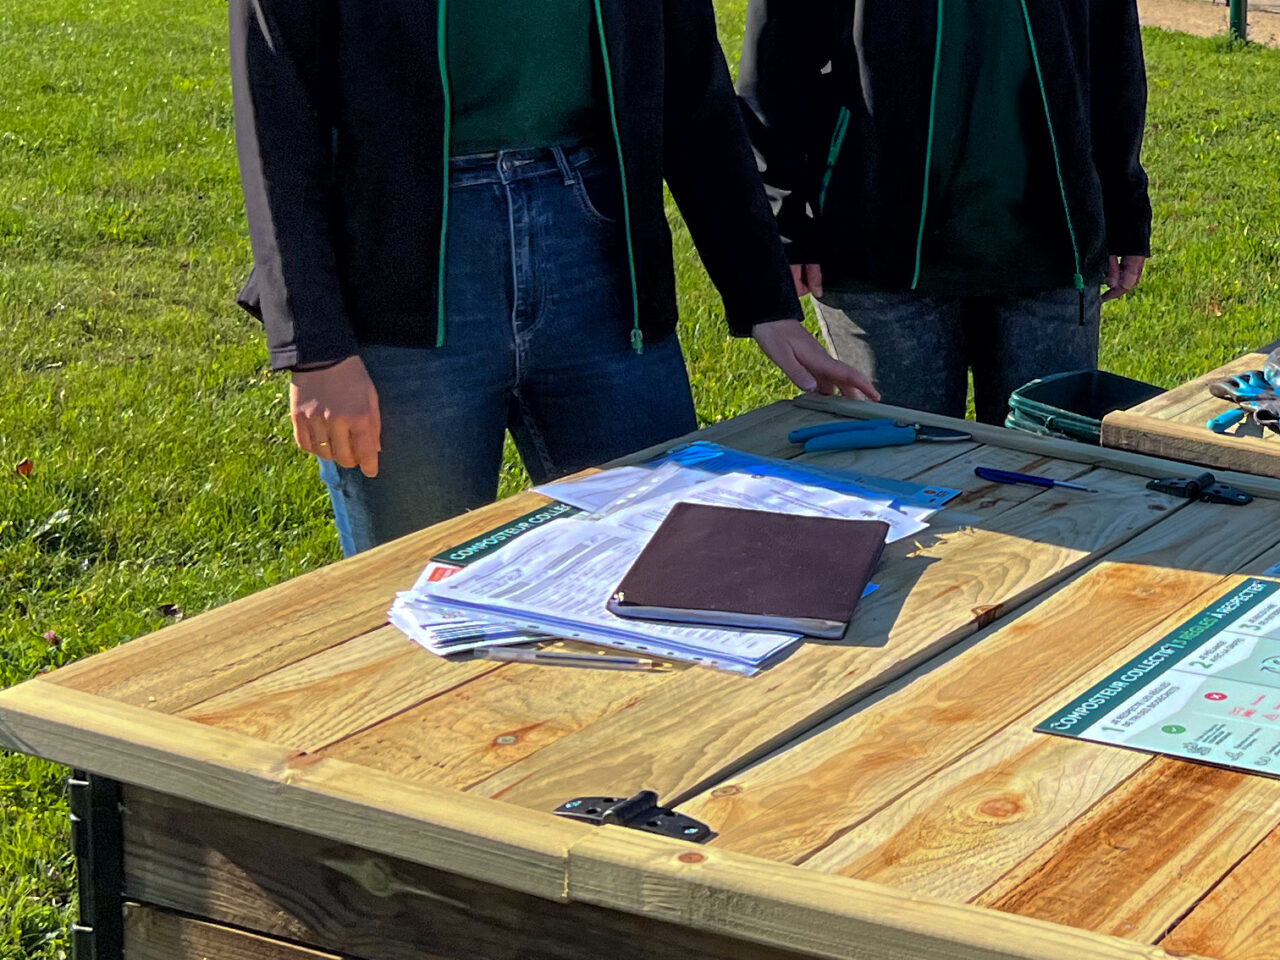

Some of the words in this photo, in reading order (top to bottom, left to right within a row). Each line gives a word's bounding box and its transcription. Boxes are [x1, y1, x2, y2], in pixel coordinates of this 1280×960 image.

[450, 522, 530, 560] COMPOSTEUR
[1238, 623, 1262, 631] 3
[1050, 680, 1131, 730] COMPOSTEUR
[1178, 615, 1219, 641] RÈGLES
[1208, 610, 1228, 619] À
[1188, 660, 1212, 668] 2
